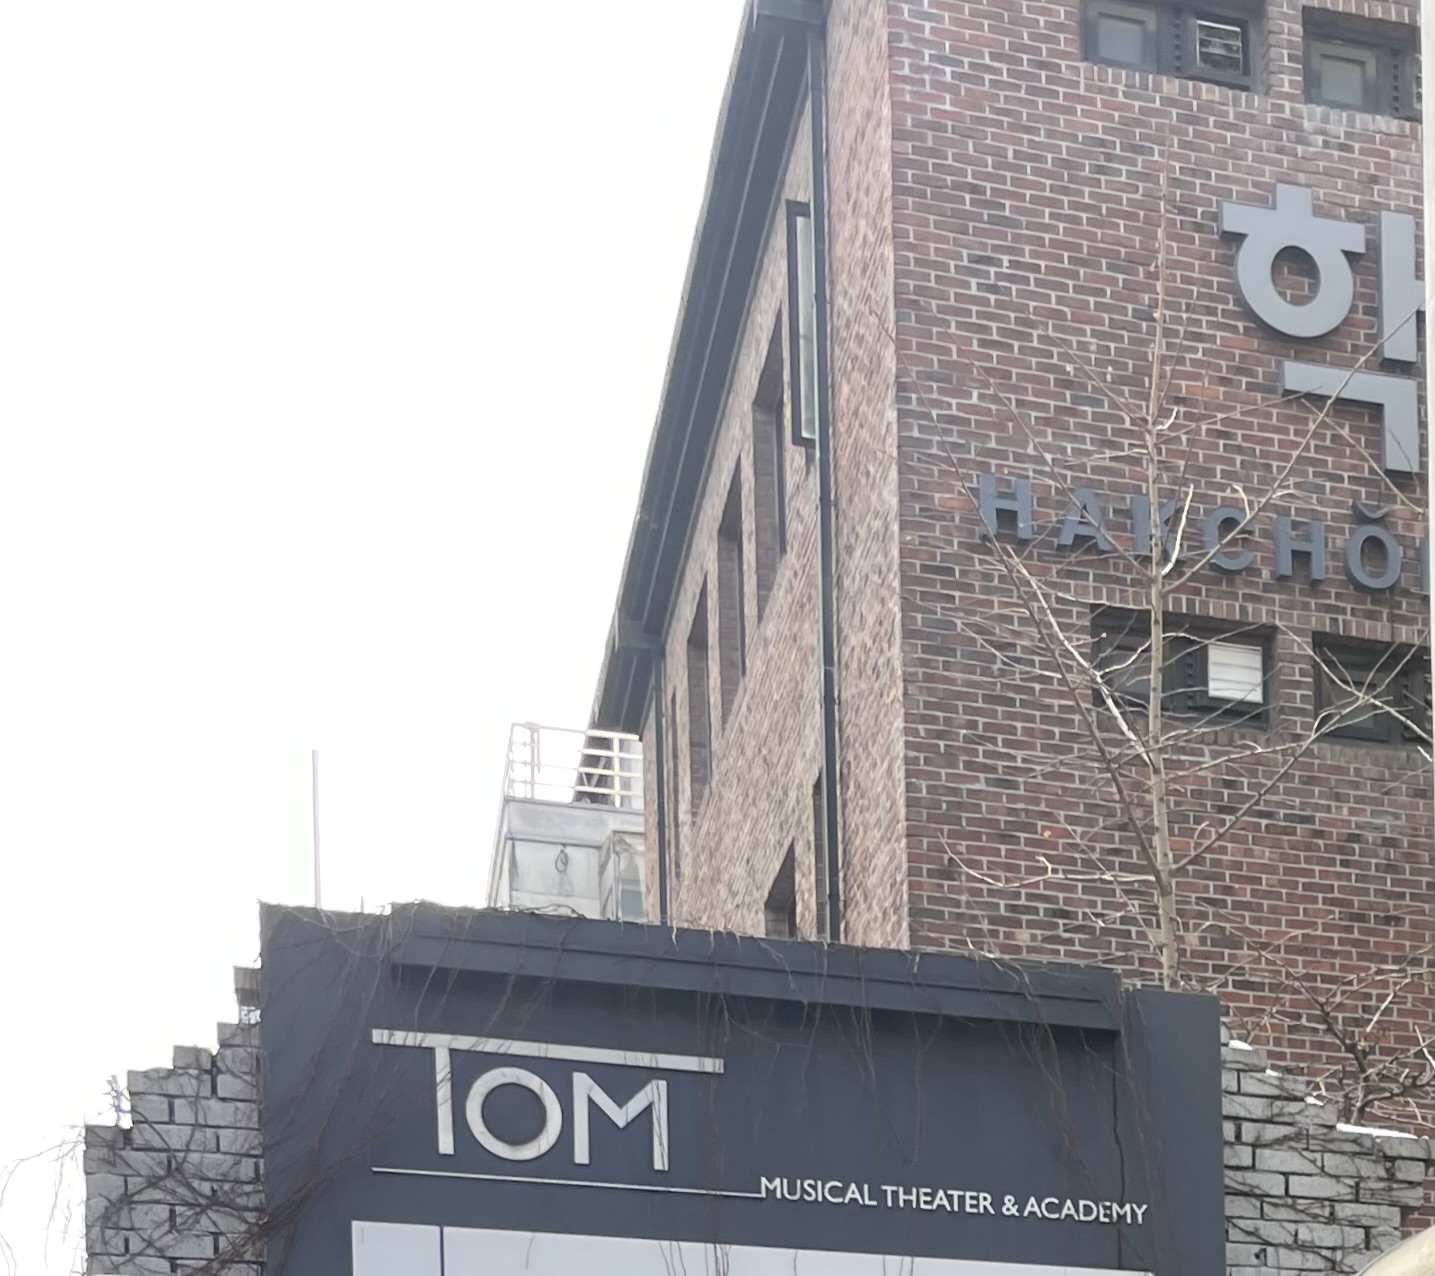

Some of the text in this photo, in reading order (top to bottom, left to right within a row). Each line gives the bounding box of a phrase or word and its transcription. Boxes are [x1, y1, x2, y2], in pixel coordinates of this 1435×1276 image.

[373, 1029, 724, 1172] TOM
[760, 1176, 1148, 1225] MUSICAL THEATER & ACADEMY
